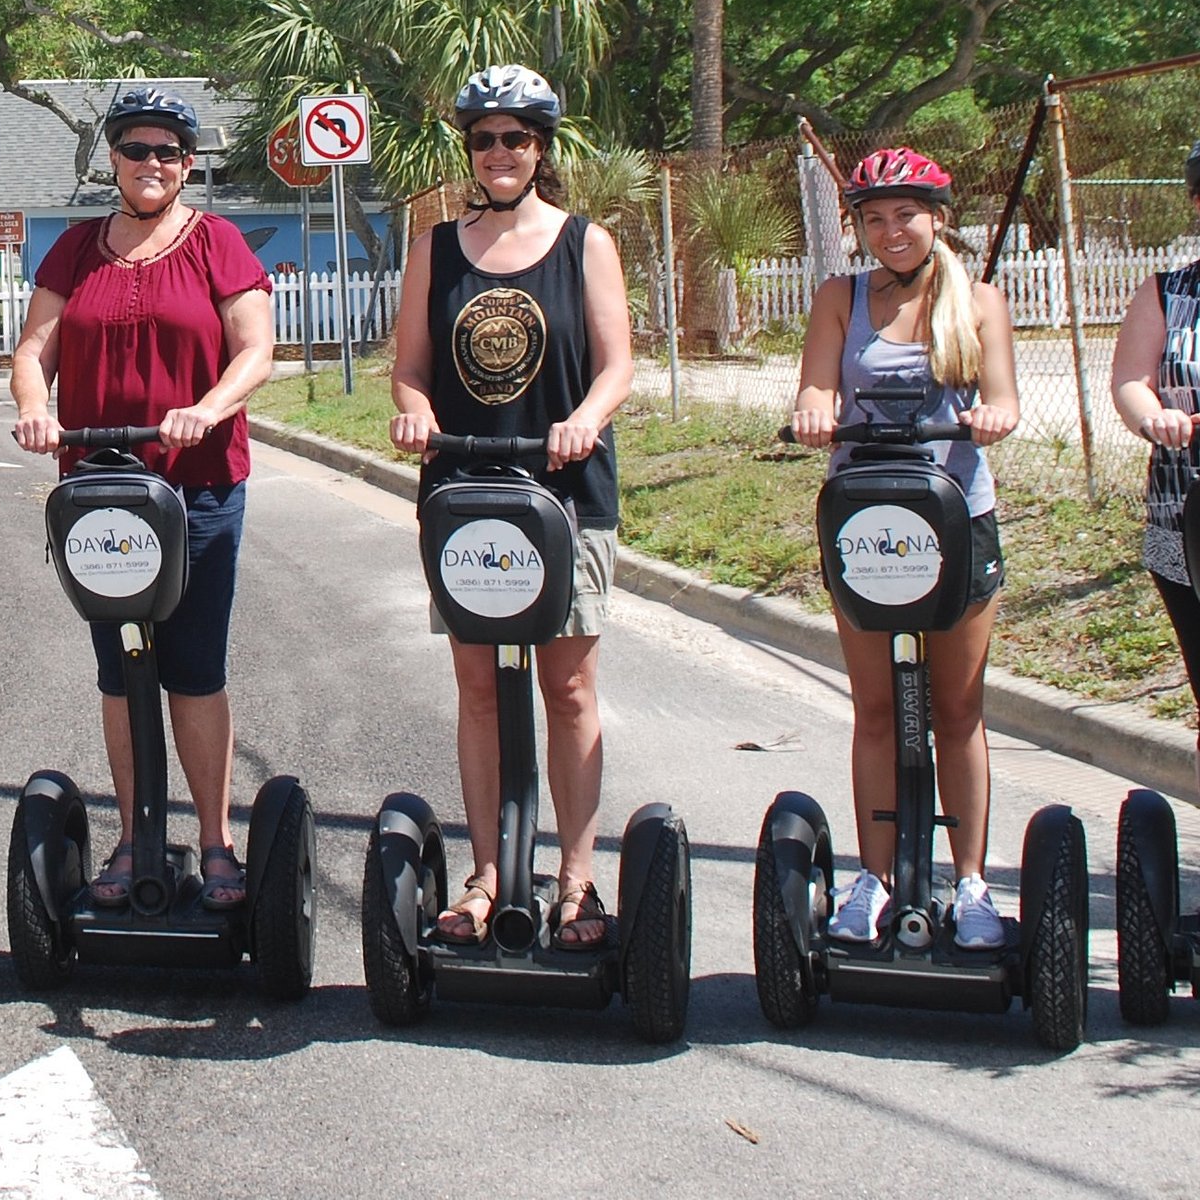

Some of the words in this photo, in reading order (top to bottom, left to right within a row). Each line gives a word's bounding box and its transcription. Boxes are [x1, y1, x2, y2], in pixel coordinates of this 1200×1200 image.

[273, 138, 300, 164] ST
[480, 295, 524, 306] COPPER
[463, 306, 537, 331] MOUNTAIN
[480, 337, 518, 350] CMB
[479, 383, 514, 395] BAND
[68, 528, 158, 555] DAYTONA
[838, 527, 941, 557] DAYTONA
[444, 541, 541, 571] DAYTONA
[902, 671, 921, 753] GWAY
